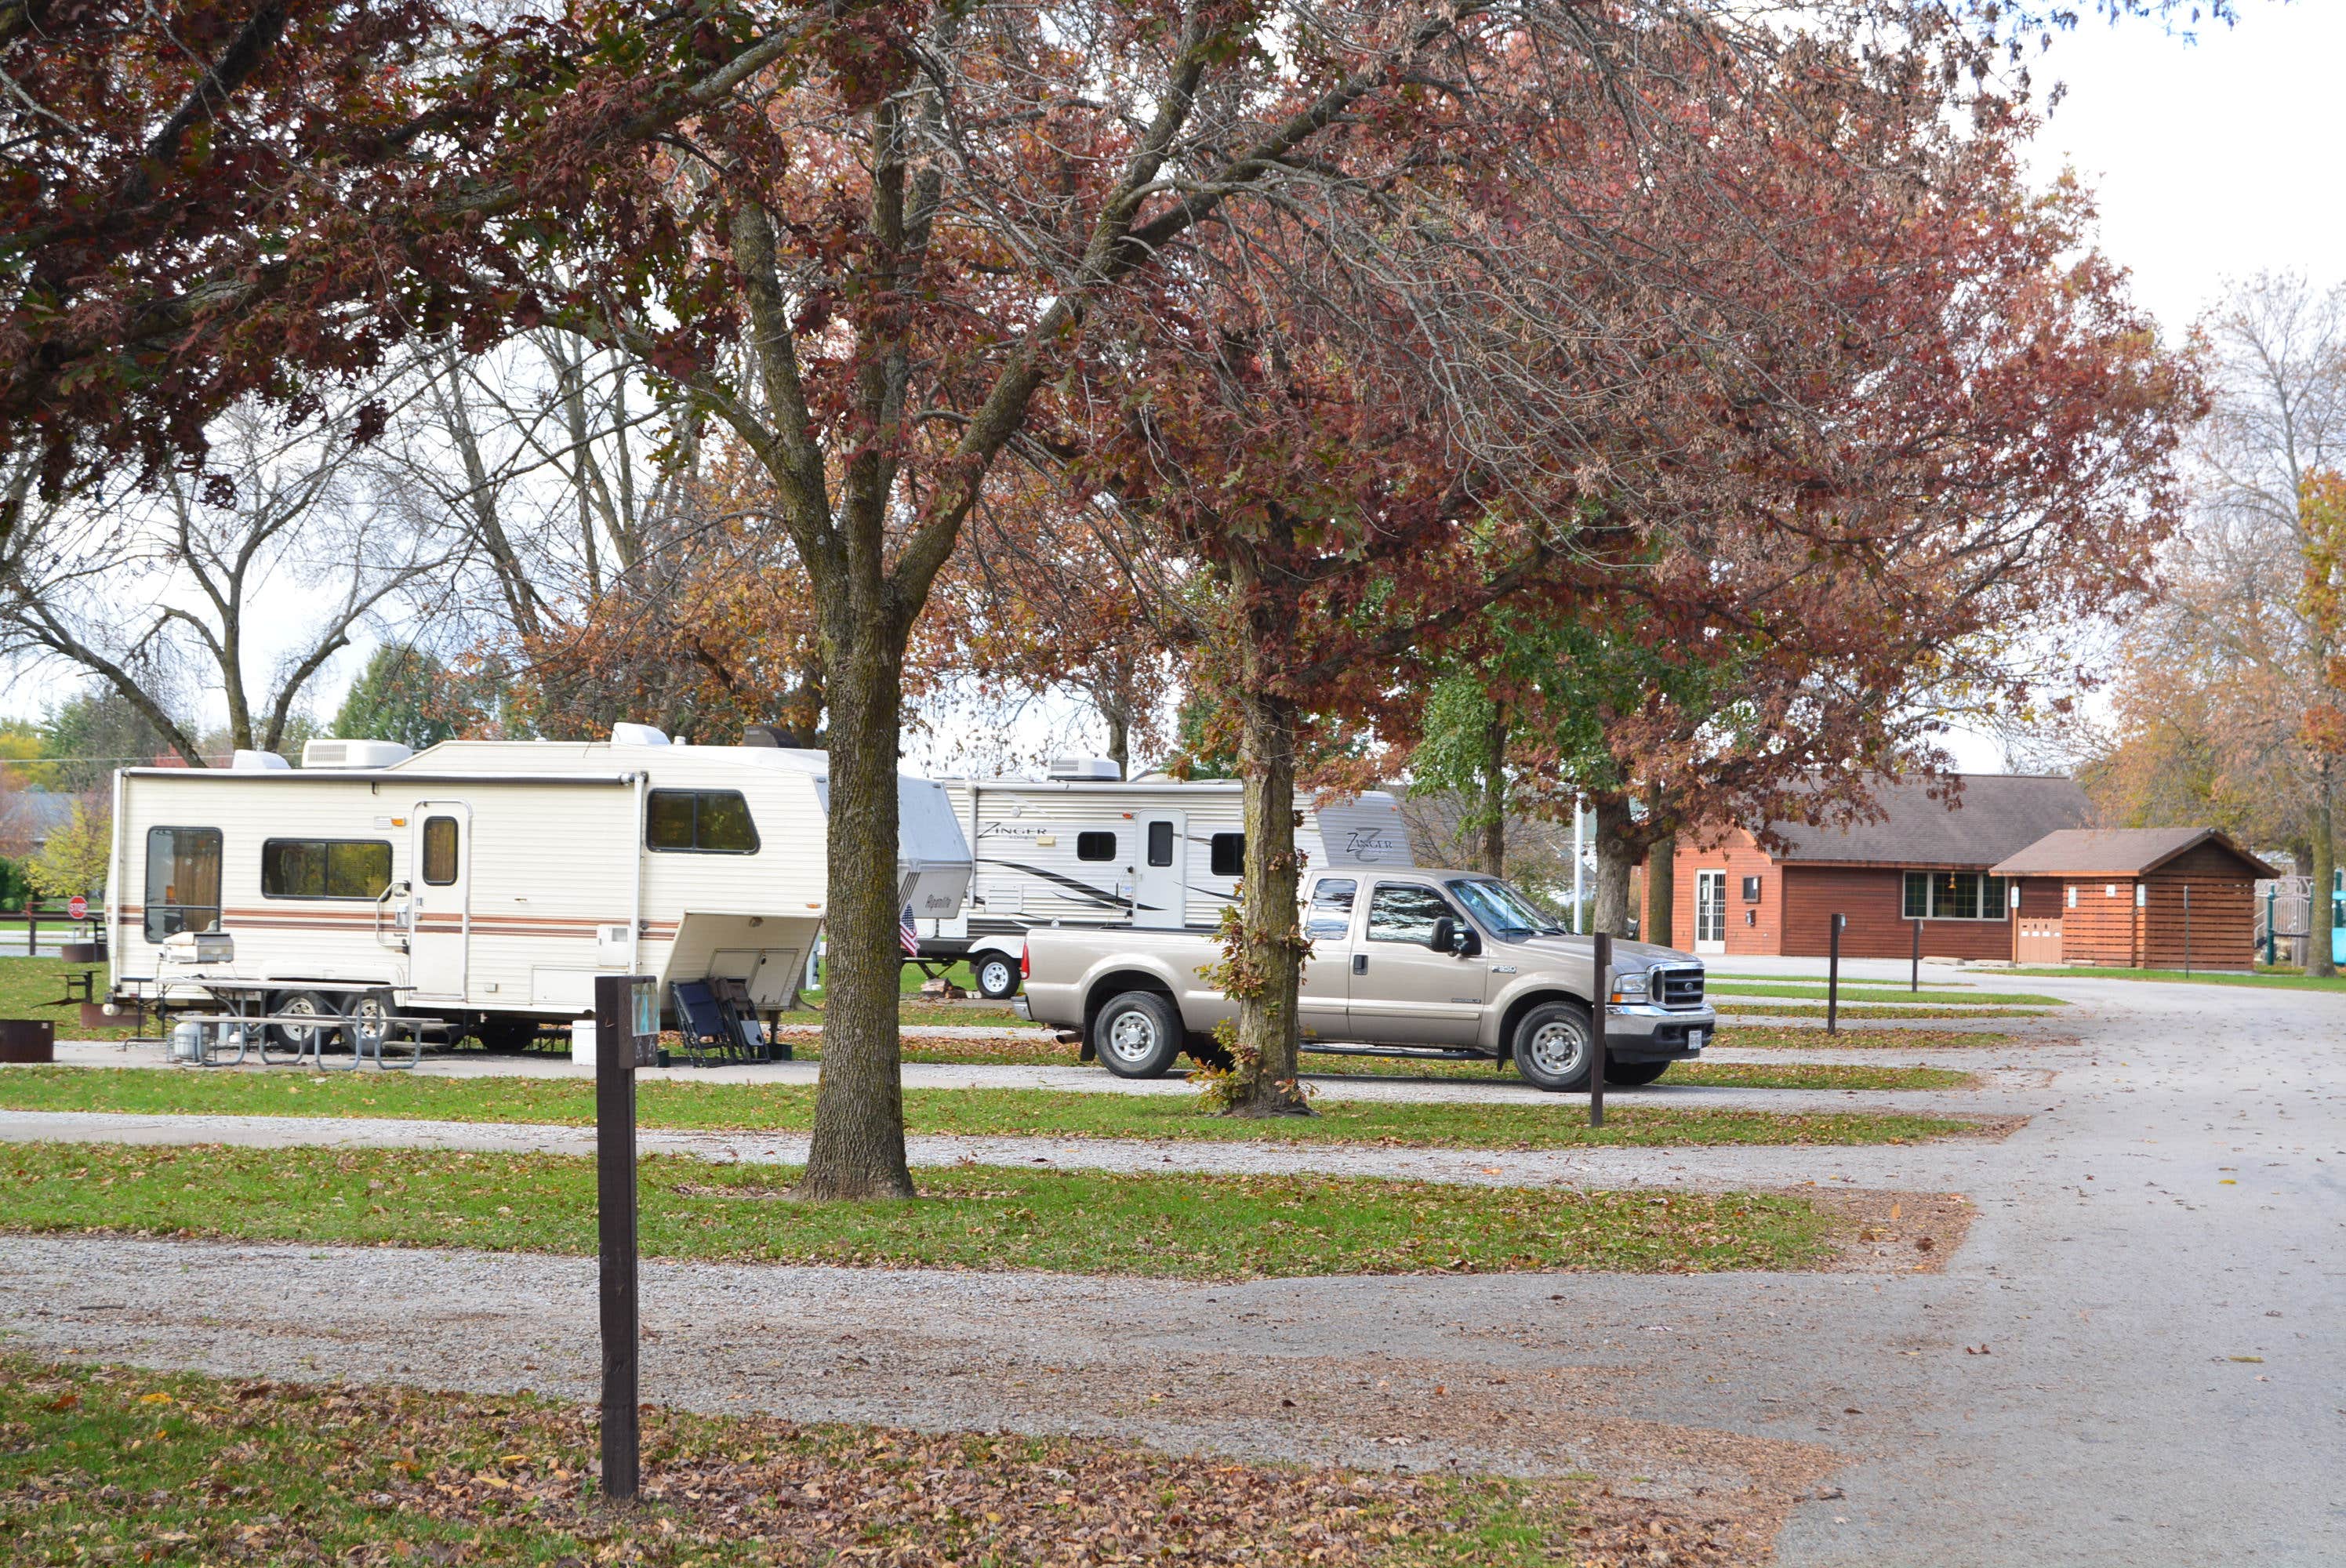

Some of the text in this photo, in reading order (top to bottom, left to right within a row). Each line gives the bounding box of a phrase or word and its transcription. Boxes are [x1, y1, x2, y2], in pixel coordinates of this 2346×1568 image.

[977, 822, 1047, 838] ZINGER
[1346, 833, 1393, 852] ZINGER
[70, 903, 87, 912] STOP
